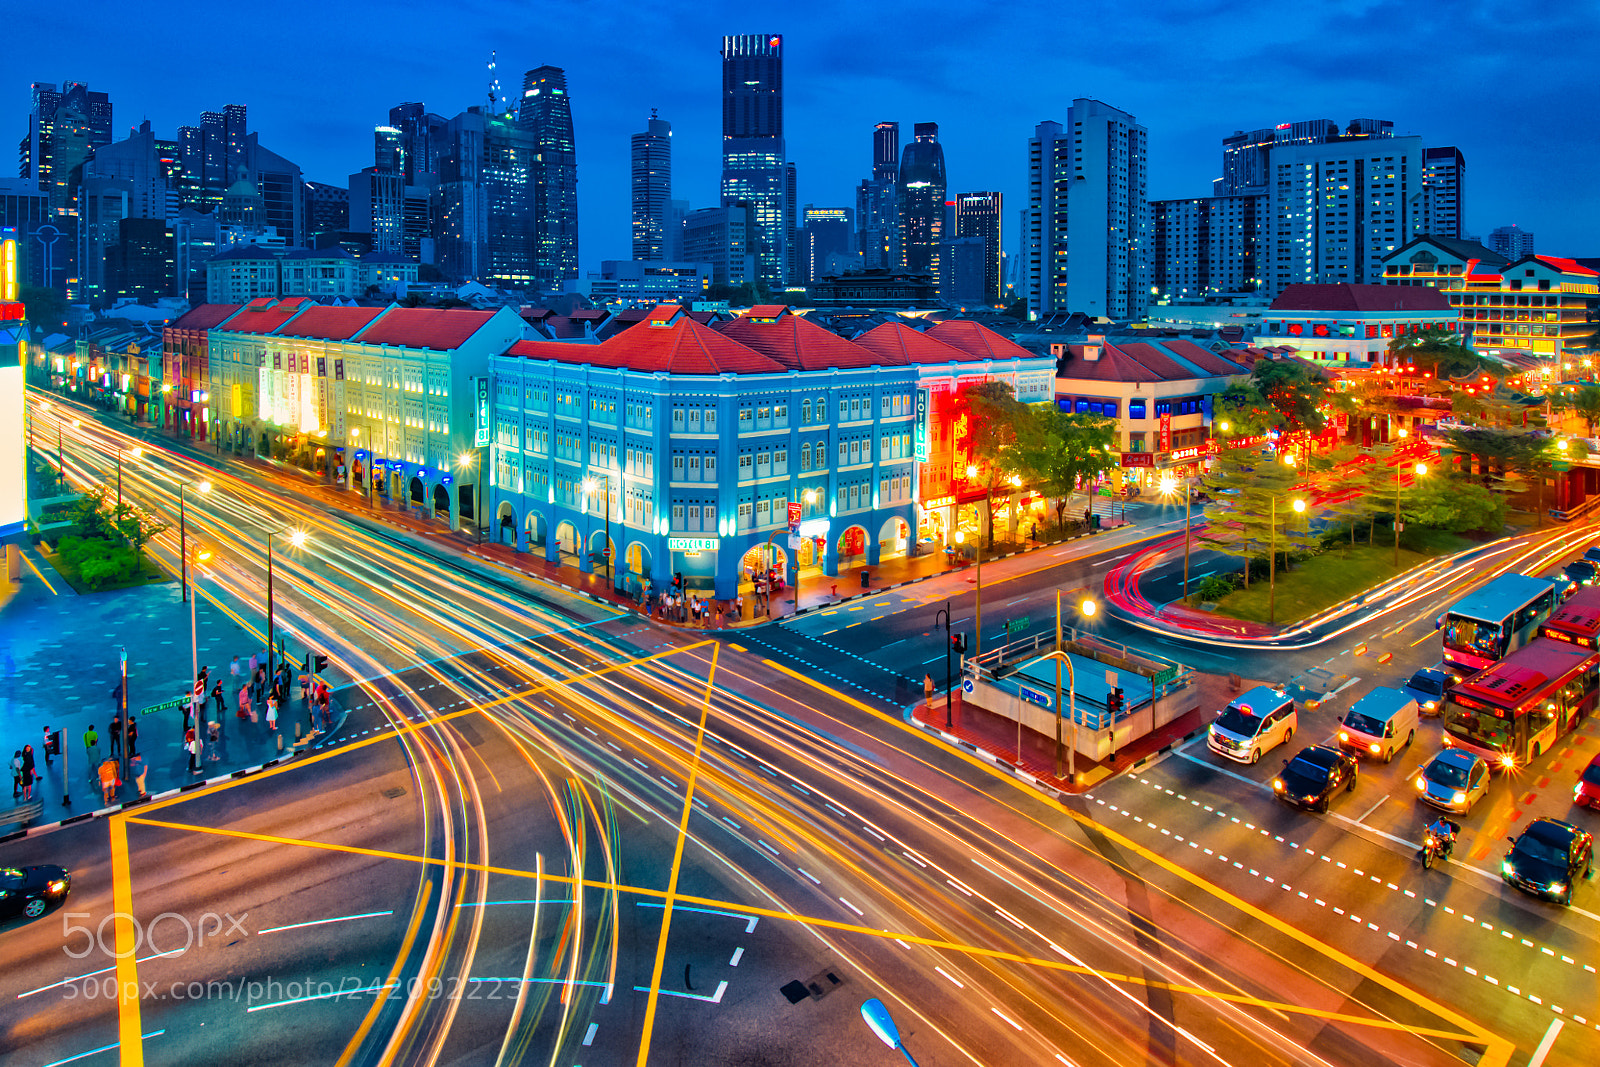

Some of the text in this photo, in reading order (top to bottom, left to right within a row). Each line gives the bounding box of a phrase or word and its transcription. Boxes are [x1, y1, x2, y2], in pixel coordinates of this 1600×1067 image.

[480, 380, 488, 426] HOTEL
[917, 392, 925, 442] HOTEL
[478, 429, 489, 441] 81
[915, 444, 926, 456] 81
[670, 539, 715, 549] HOTEL 81
[1494, 707, 1505, 718] 33
